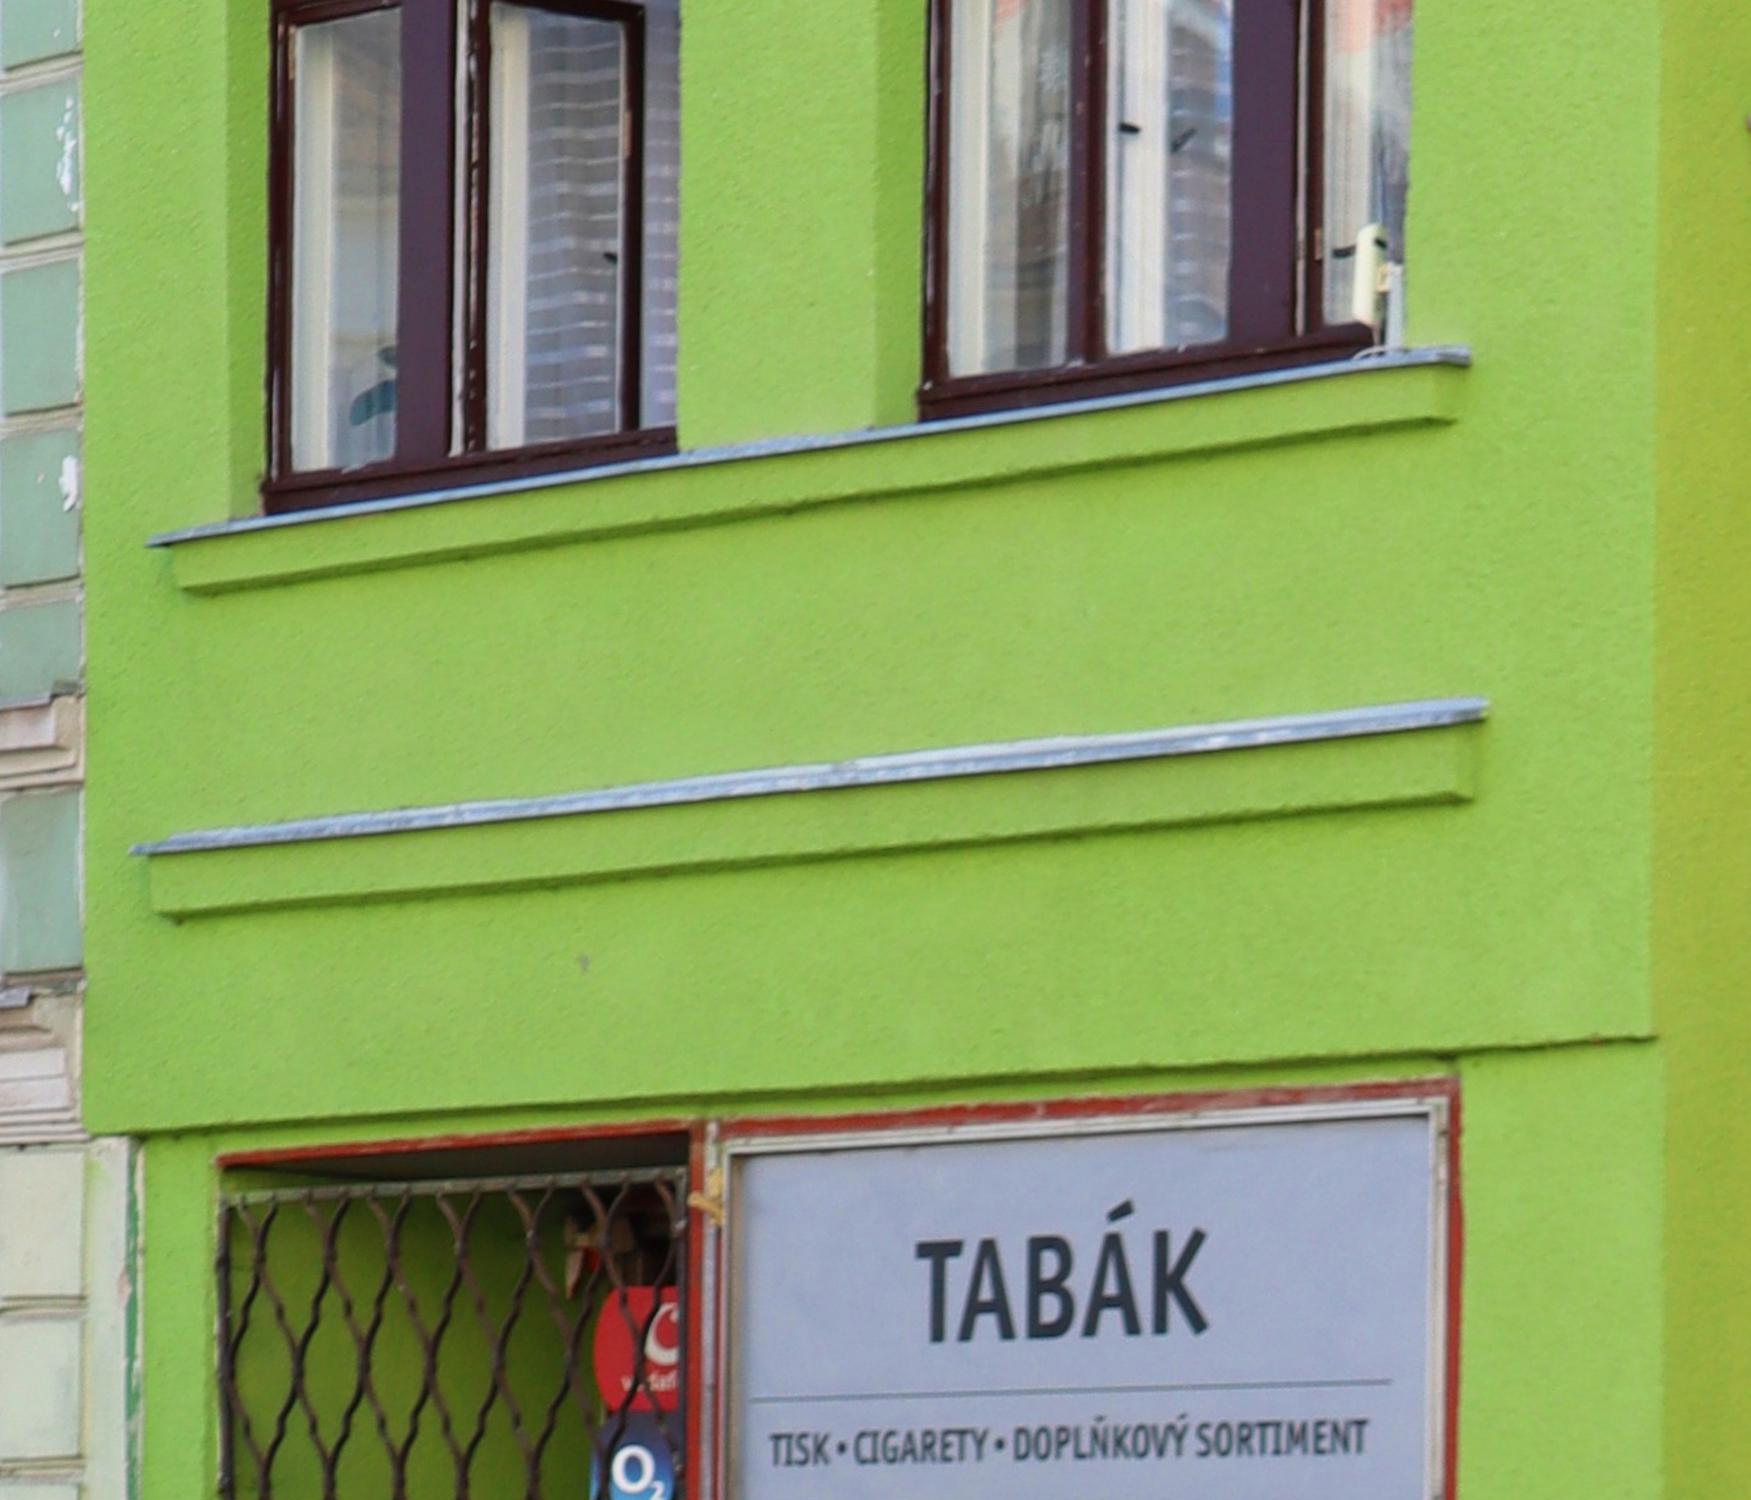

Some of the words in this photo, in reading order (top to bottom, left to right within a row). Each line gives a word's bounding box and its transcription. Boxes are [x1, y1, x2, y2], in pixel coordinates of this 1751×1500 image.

[916, 1200, 1208, 1343] TABÁK
[769, 1431, 829, 1466] TISK
[854, 1428, 988, 1465] CIGARETY
[1013, 1414, 1188, 1462] DOPLŇKOVÝ
[1196, 1418, 1369, 1457] SORTIMENT
